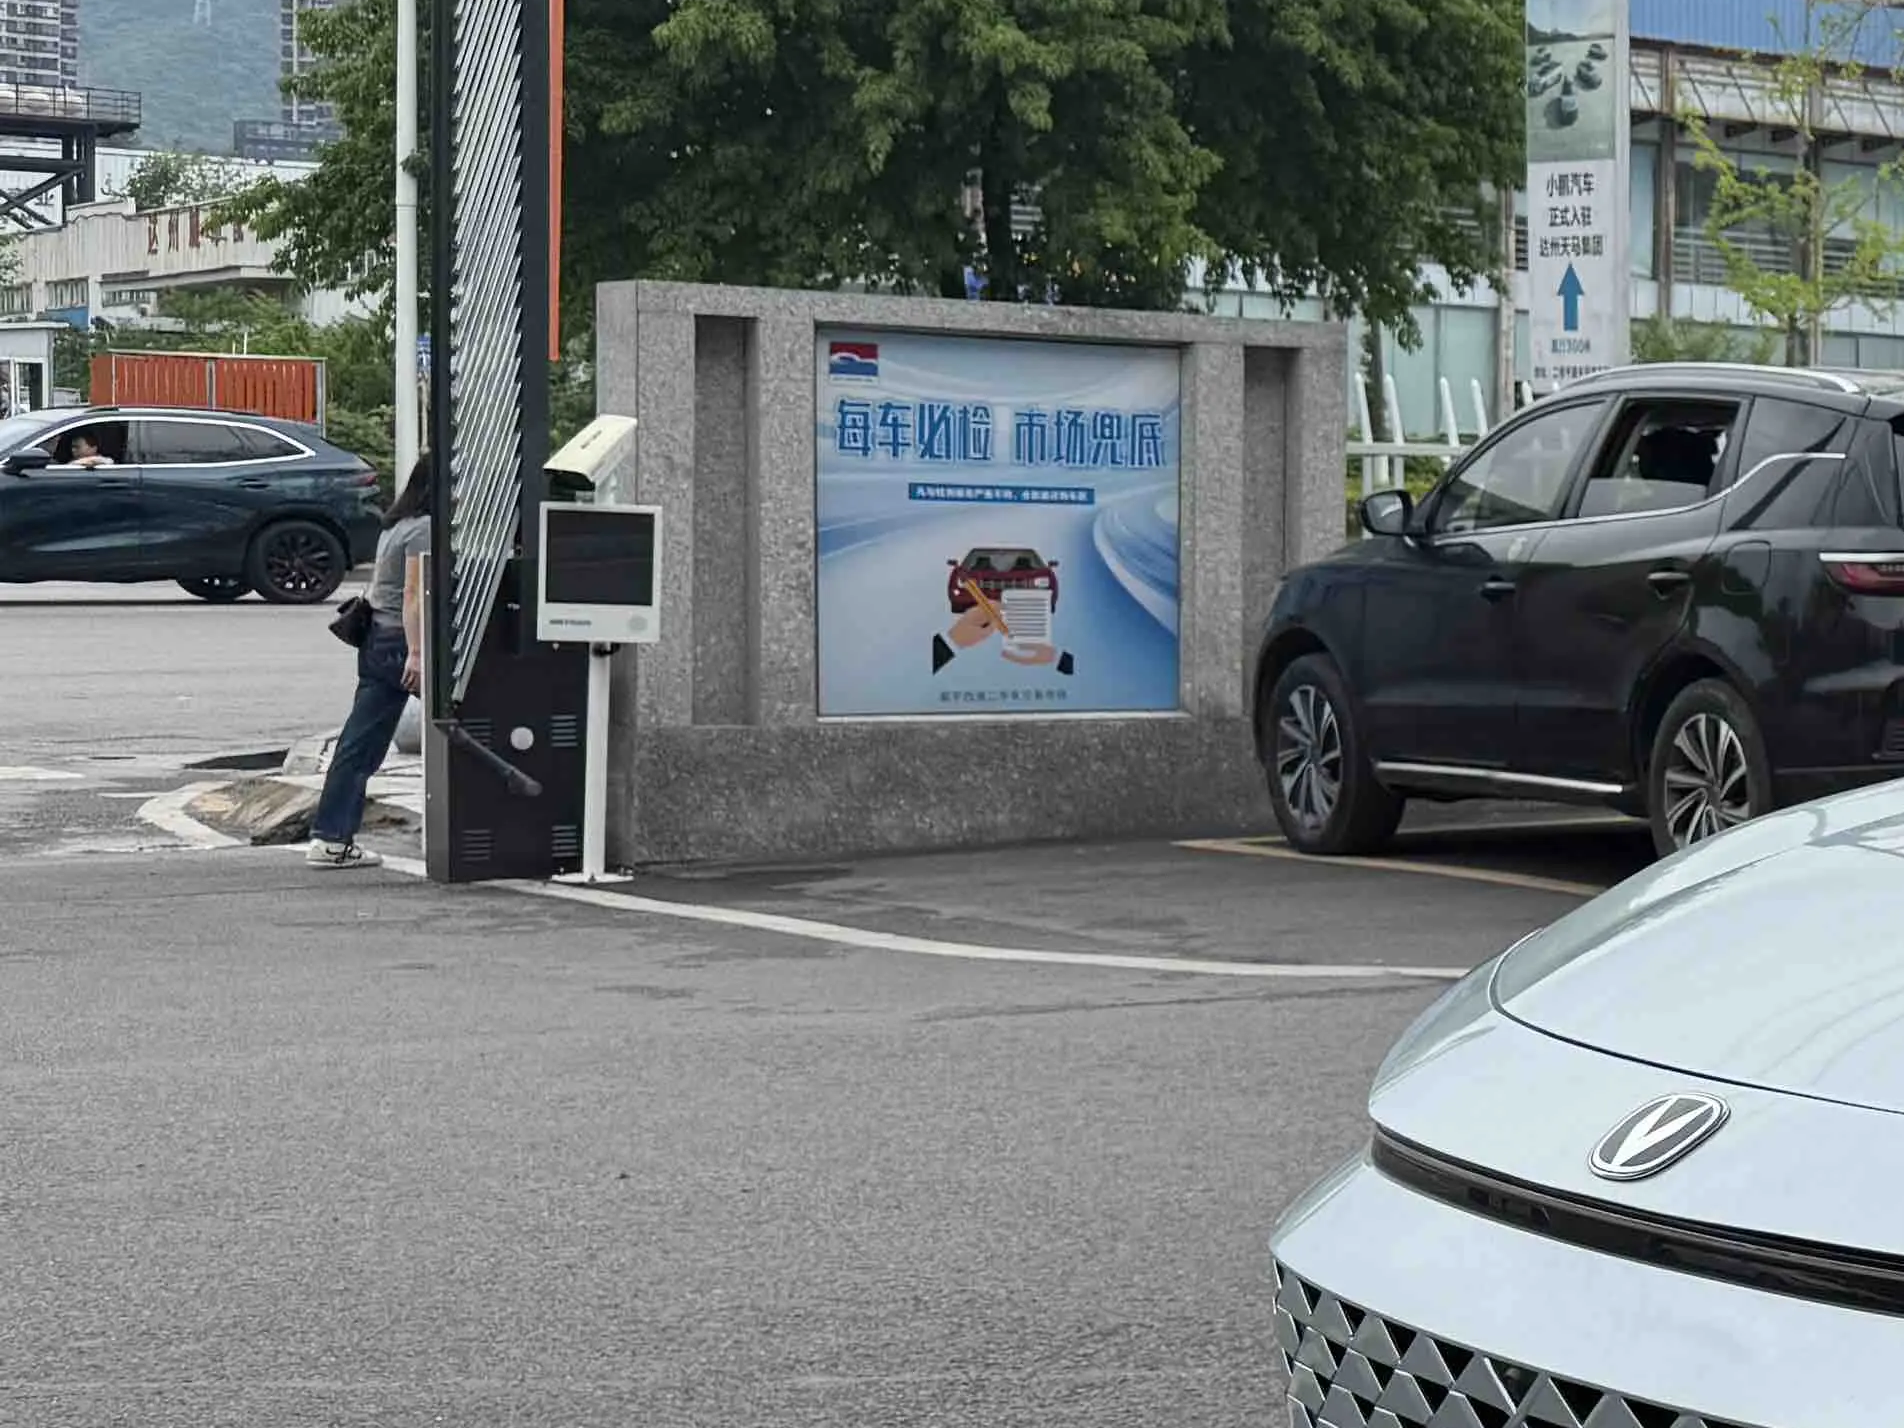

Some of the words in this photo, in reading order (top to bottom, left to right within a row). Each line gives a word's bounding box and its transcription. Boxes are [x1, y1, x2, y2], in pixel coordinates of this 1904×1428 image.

[837, 398, 993, 462] 每车必检
[1015, 409, 1163, 467] 市场兜底
